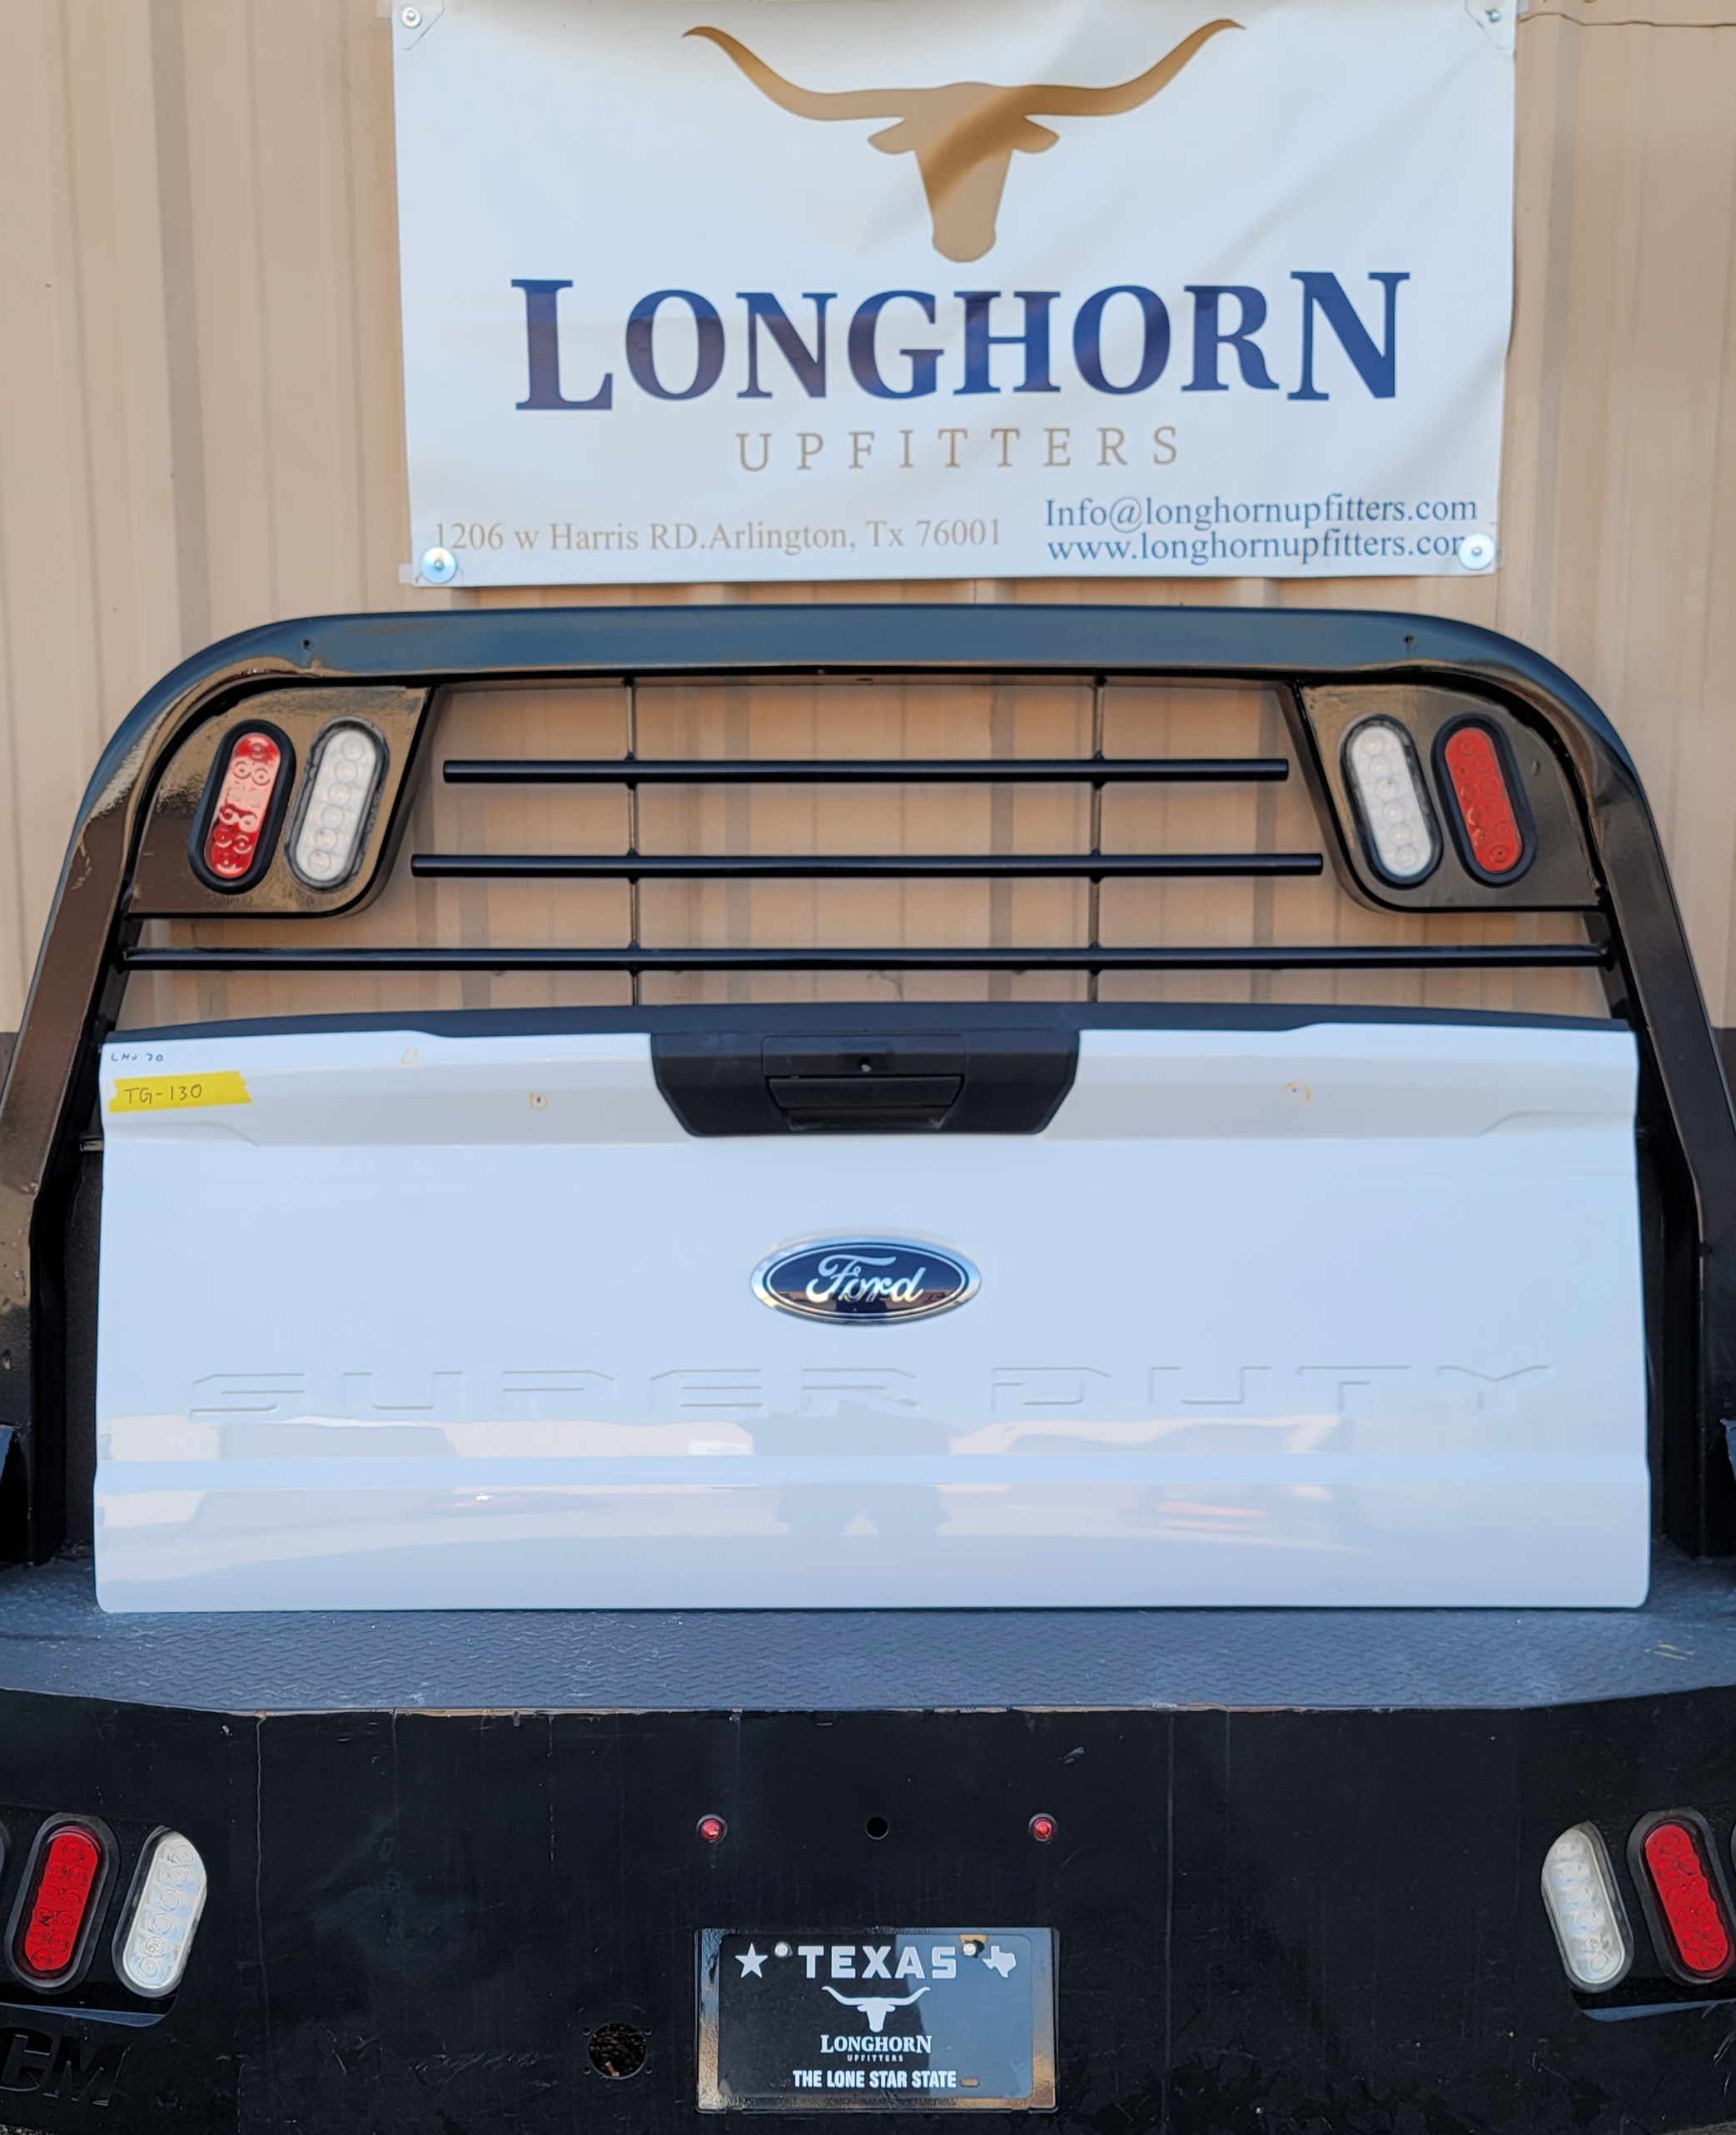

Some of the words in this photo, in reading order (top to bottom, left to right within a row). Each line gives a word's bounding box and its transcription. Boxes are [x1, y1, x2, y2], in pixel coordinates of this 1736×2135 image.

[510, 271, 1411, 411] LONGHORN
[735, 426, 1178, 472] UPFITTERS
[1045, 493, 1478, 534] Info@longhornupfitters.com
[435, 522, 505, 550] 1206
[550, 520, 639, 551] Harris
[866, 520, 904, 550] Tx
[916, 519, 1000, 548] 76001
[145, 1053, 164, 1063] 70
[124, 1082, 203, 1106] TG-130
[805, 1254, 927, 1304] Ford
[188, 1366, 921, 1422] SUPER
[991, 1363, 1551, 1414] DUTY
[797, 1945, 957, 1979] TEXAS
[819, 2034, 933, 2054] LONGHORN
[847, 2053, 904, 2063] UPFITTERS
[792, 2069, 822, 2088] THE
[826, 2069, 866, 2088] LONE
[869, 2069, 908, 2088] STAR
[912, 2069, 958, 2088] STATE
